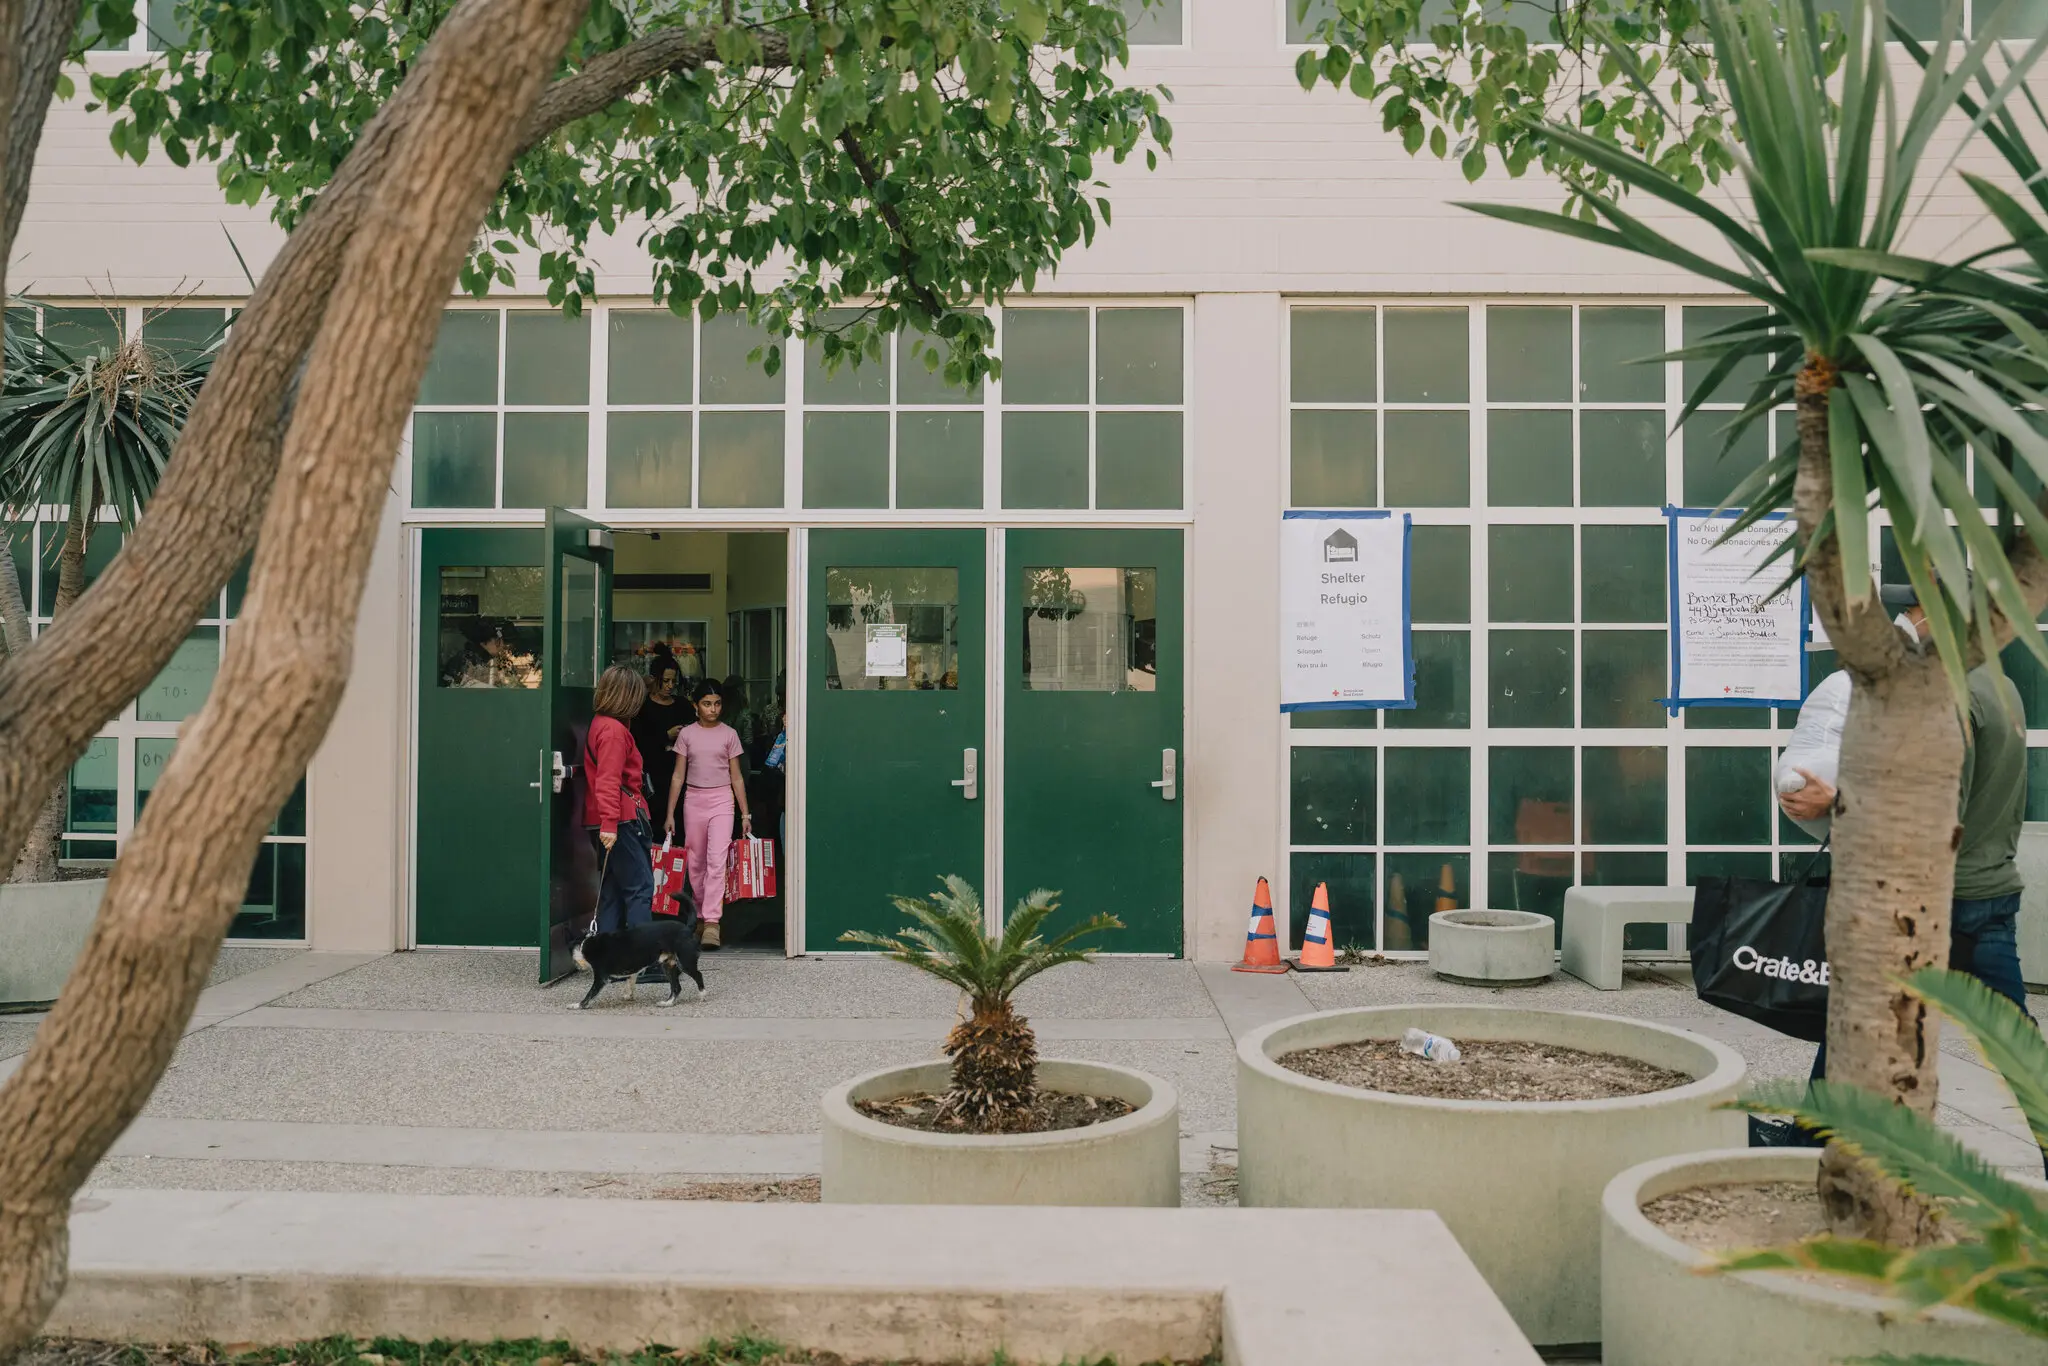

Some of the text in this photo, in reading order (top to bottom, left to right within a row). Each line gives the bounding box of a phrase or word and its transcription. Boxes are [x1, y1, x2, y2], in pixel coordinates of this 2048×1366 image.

[1689, 524, 1701, 532] Do
[1701, 538, 1719, 547] Dej
[1321, 572, 1366, 584] Shelter
[1320, 592, 1368, 606] Refugio
[1687, 592, 1727, 605] Bronze
